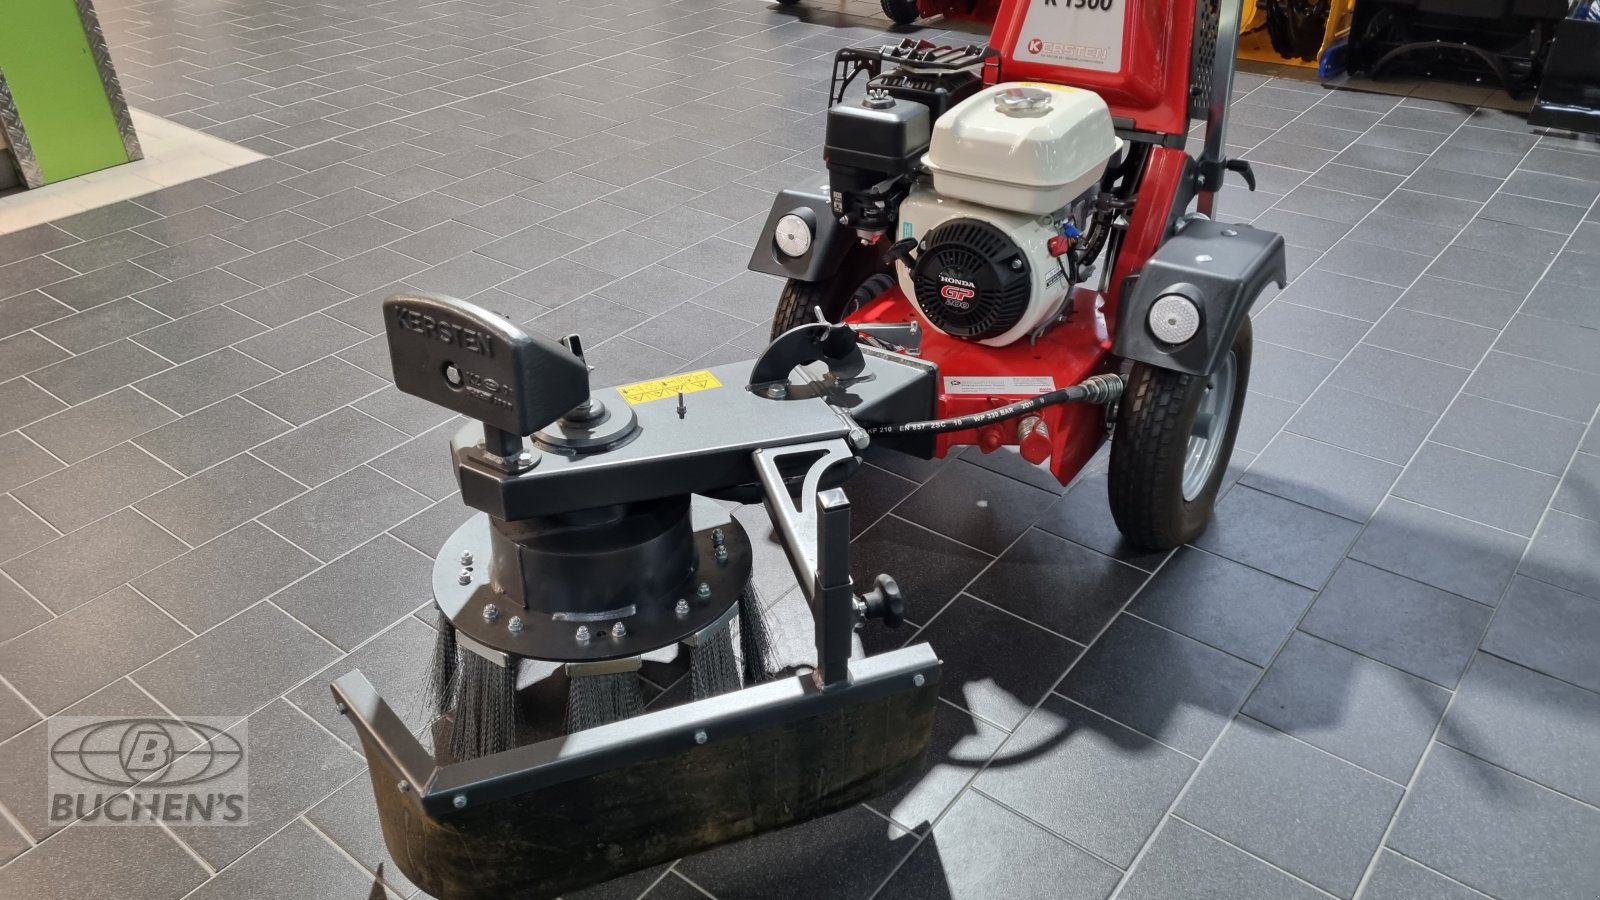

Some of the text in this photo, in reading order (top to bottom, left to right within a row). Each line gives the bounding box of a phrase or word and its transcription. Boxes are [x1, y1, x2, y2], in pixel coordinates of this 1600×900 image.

[1027, 38, 1108, 59] KERSTEN
[940, 275, 976, 289] HONDA
[940, 285, 975, 301] GP
[395, 304, 496, 358] KERSTEN
[912, 423, 926, 431] 857
[930, 421, 947, 429] 2SC
[953, 419, 963, 427] 10
[973, 414, 985, 423] WP
[986, 411, 999, 420] 330
[999, 407, 1015, 417] BAR
